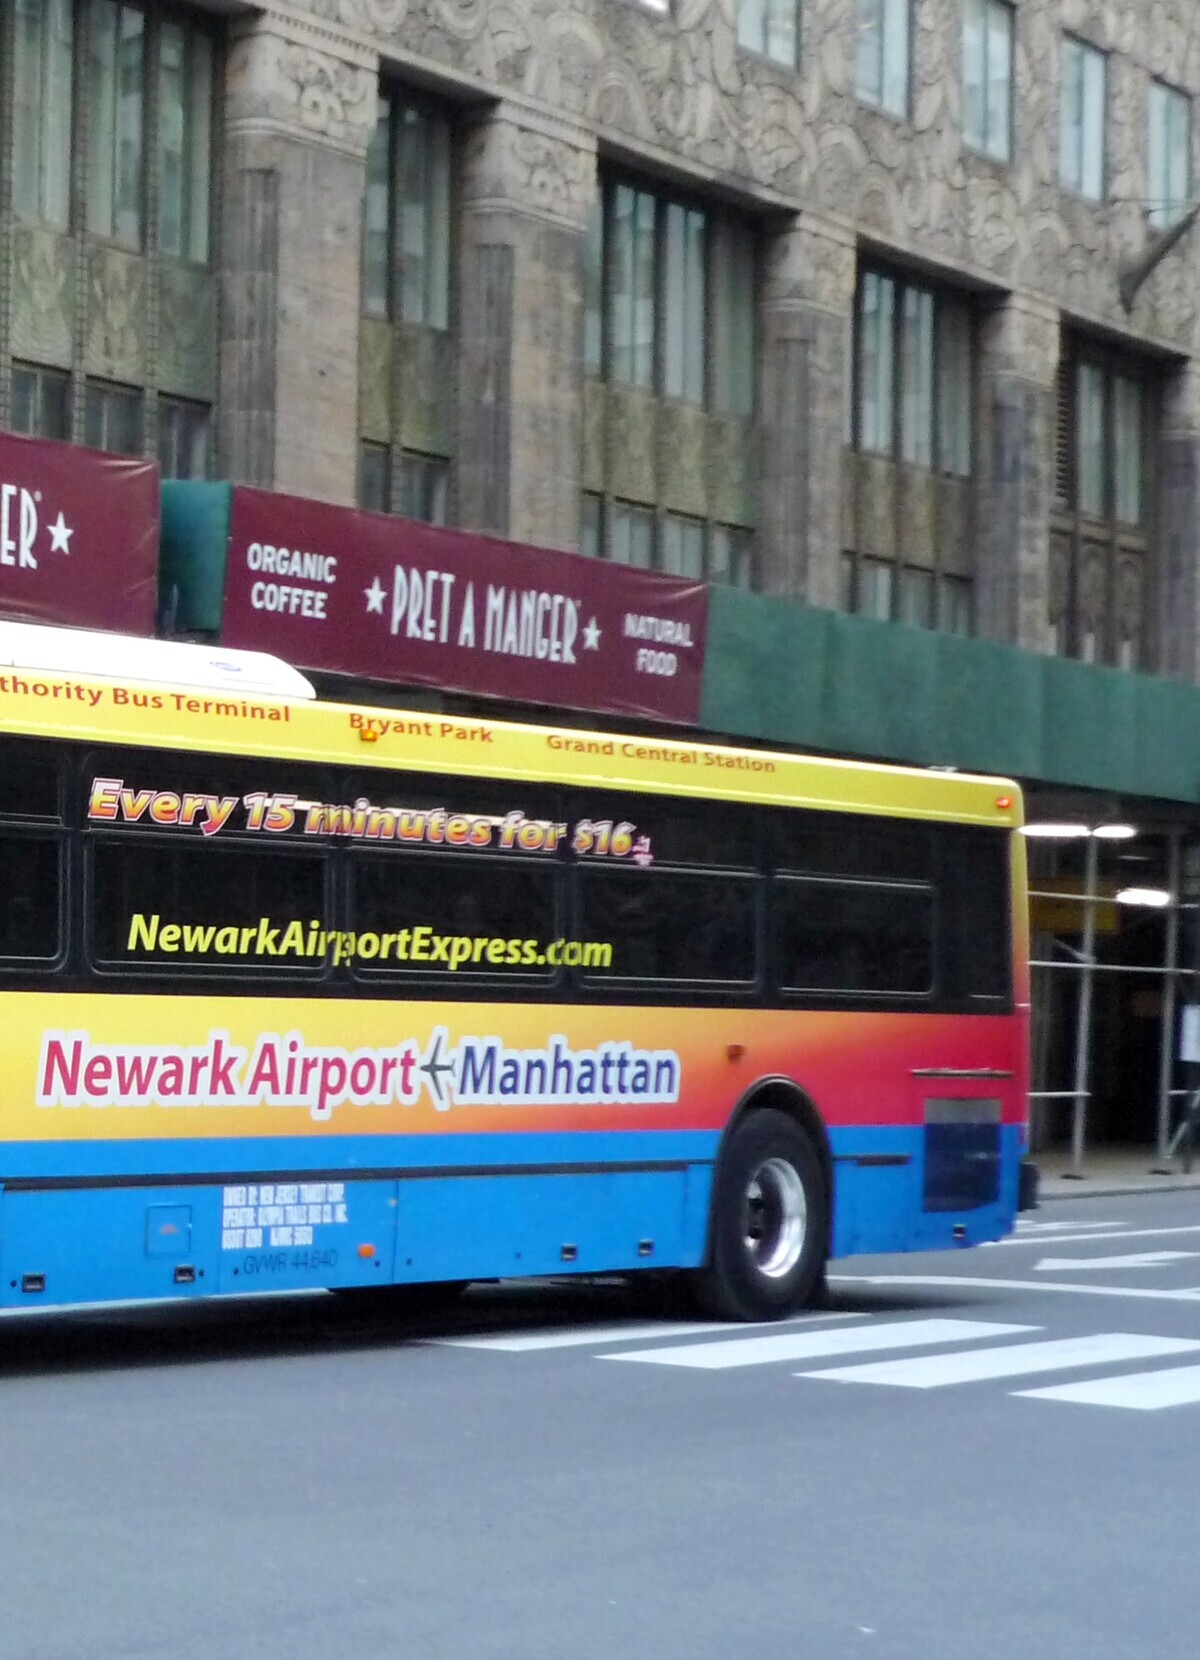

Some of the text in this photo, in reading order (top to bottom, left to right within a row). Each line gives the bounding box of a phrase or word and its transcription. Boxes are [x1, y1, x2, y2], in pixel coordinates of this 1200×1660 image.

[247, 543, 336, 583] ORGANIC
[251, 582, 328, 620] COFFEE
[390, 564, 577, 664] PRET A MANGER
[624, 613, 694, 648] NATURAL
[636, 648, 677, 676] FOOD
[112, 687, 163, 710] Bus
[171, 694, 291, 722] Terminal
[349, 713, 493, 743] Bryant Park
[546, 734, 776, 774] Grand Central Station
[88, 777, 238, 836] Every
[243, 791, 298, 832] 15
[304, 797, 491, 846] minutes
[499, 810, 567, 852] for
[127, 913, 612, 971] NewarkAirportExpress.com
[41, 1038, 677, 1110] Newark Airport Manhattan
[243, 1252, 287, 1275] GVWR
